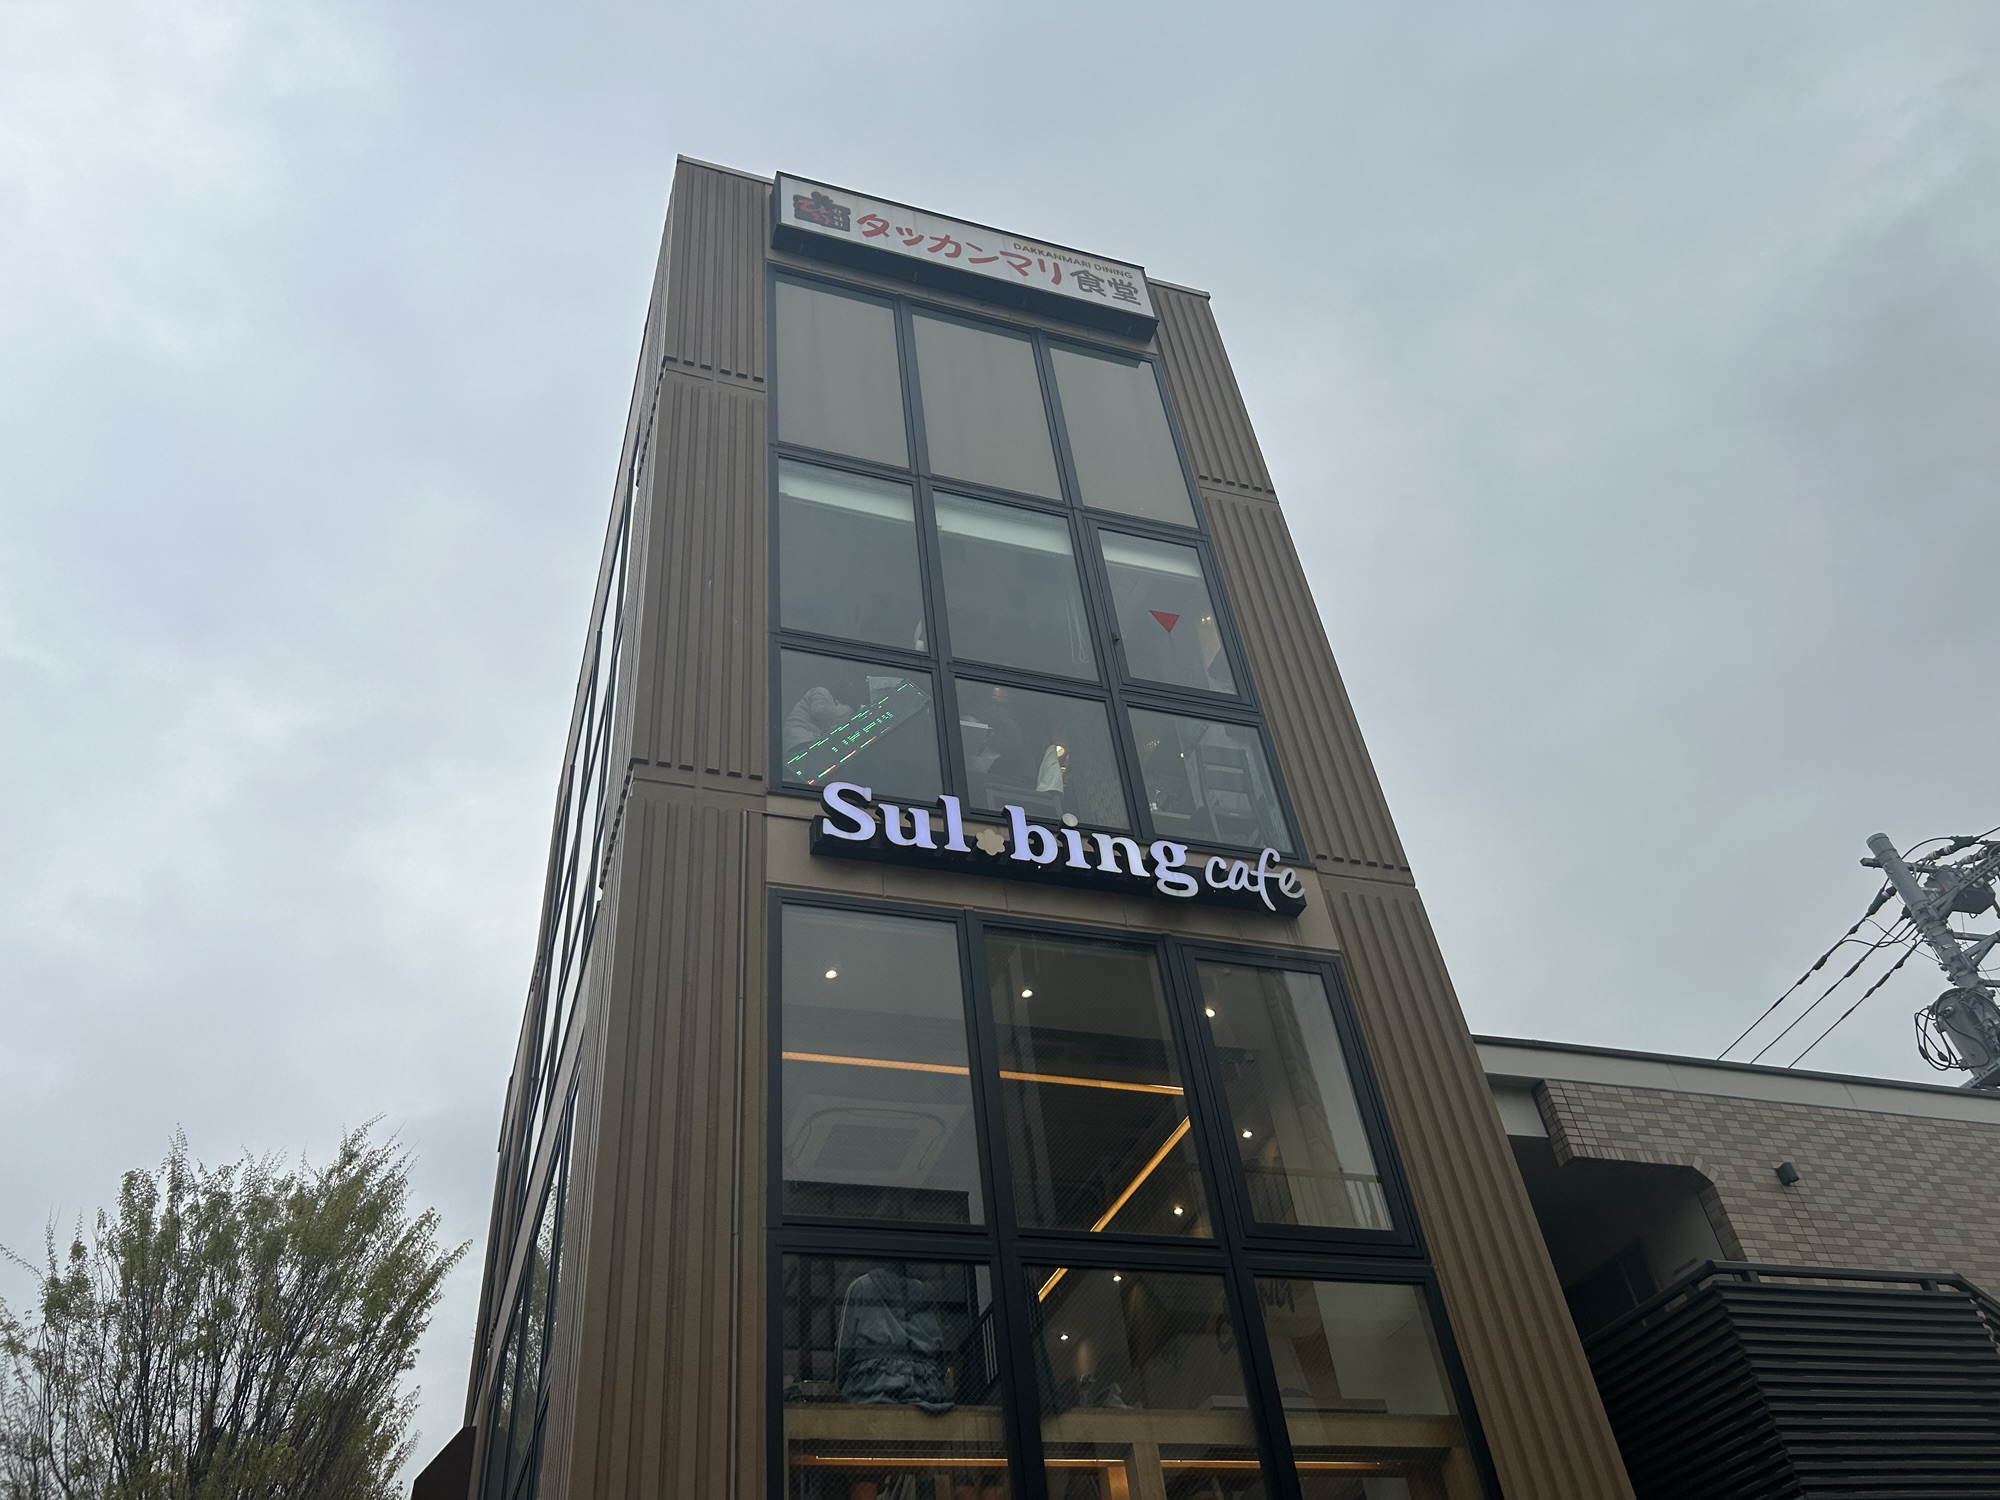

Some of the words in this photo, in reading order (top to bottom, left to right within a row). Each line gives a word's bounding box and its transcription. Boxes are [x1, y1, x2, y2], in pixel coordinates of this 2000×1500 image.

[1013, 242, 1092, 269] DAKKANMARI
[1094, 263, 1133, 279] DINING
[1204, 847, 1305, 912] cafe
